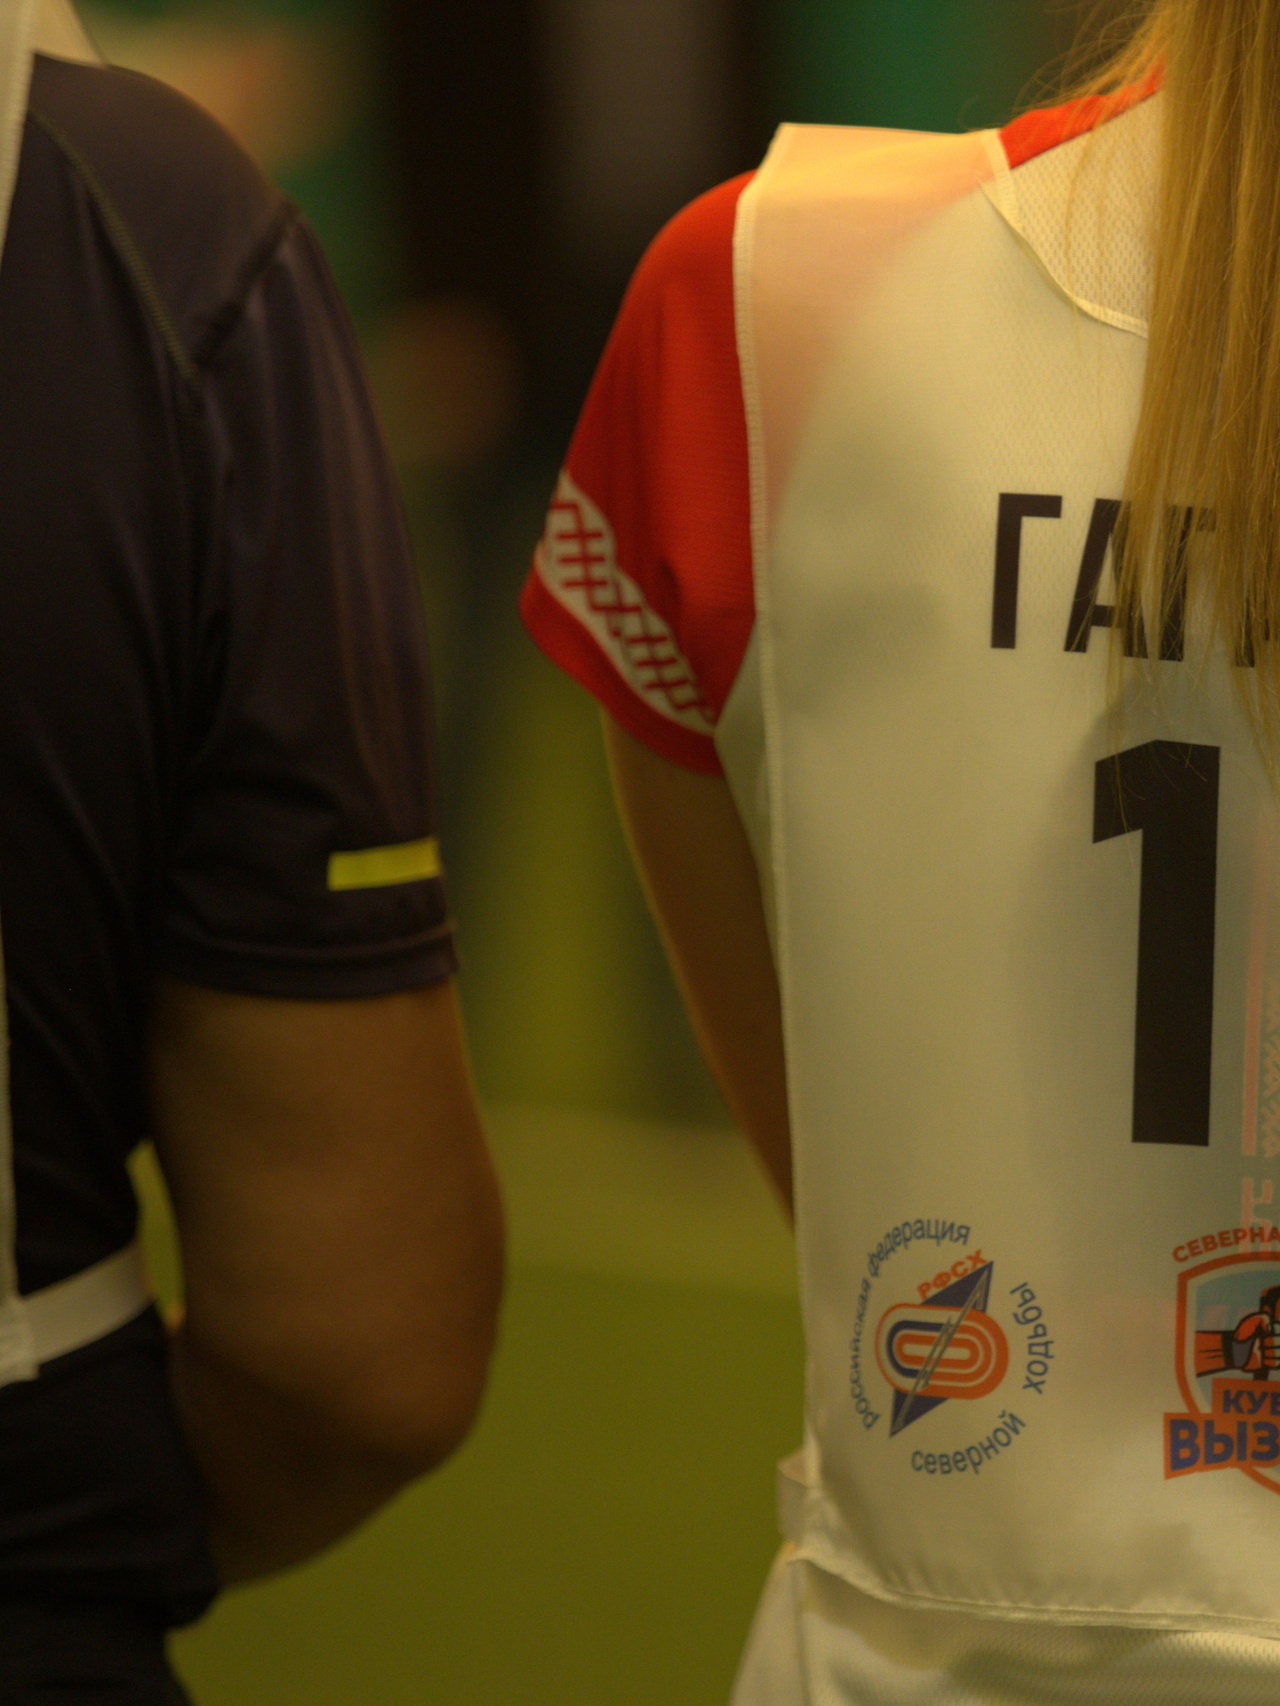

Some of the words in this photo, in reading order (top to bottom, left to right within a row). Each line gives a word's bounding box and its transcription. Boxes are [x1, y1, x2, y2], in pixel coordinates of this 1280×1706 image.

[867, 1218, 971, 1278] федерация
[916, 1248, 989, 1300] РФСХ
[911, 1410, 1027, 1475] северной
[1010, 1281, 1054, 1395] ходьбы
